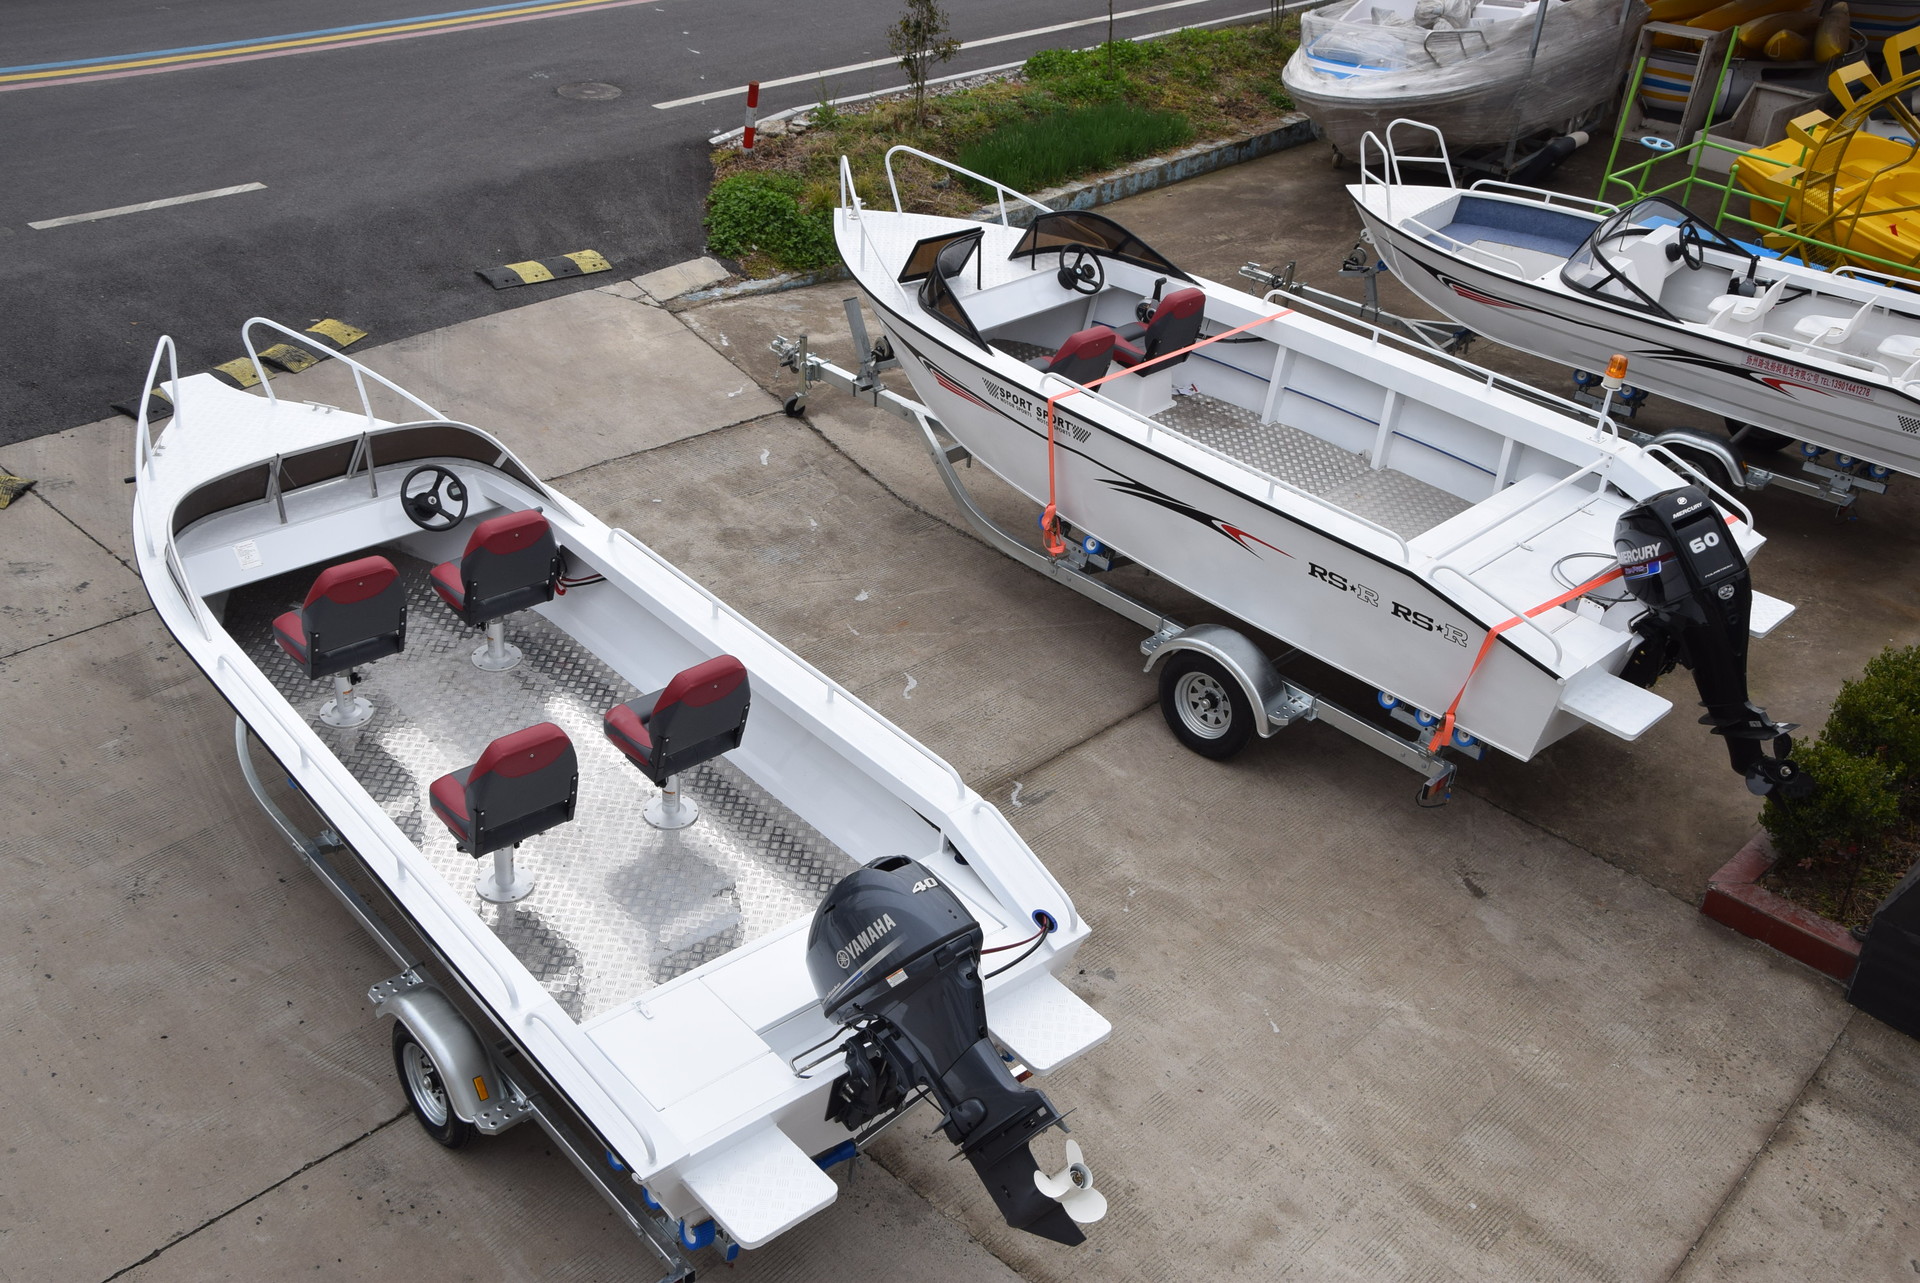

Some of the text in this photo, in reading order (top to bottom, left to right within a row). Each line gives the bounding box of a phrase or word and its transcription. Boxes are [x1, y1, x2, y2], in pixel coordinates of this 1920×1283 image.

[999, 387, 1033, 411] SPORT
[1000, 398, 1015, 408] MOTOR
[1016, 405, 1032, 417] SPORTS
[1054, 425, 1071, 437] SPORTS
[1672, 501, 1704, 520] MERCURY
[1617, 542, 1662, 563] MERCURY
[1688, 531, 1720, 554] 60
[911, 877, 938, 895] 40
[844, 912, 897, 961] YAMAHA
